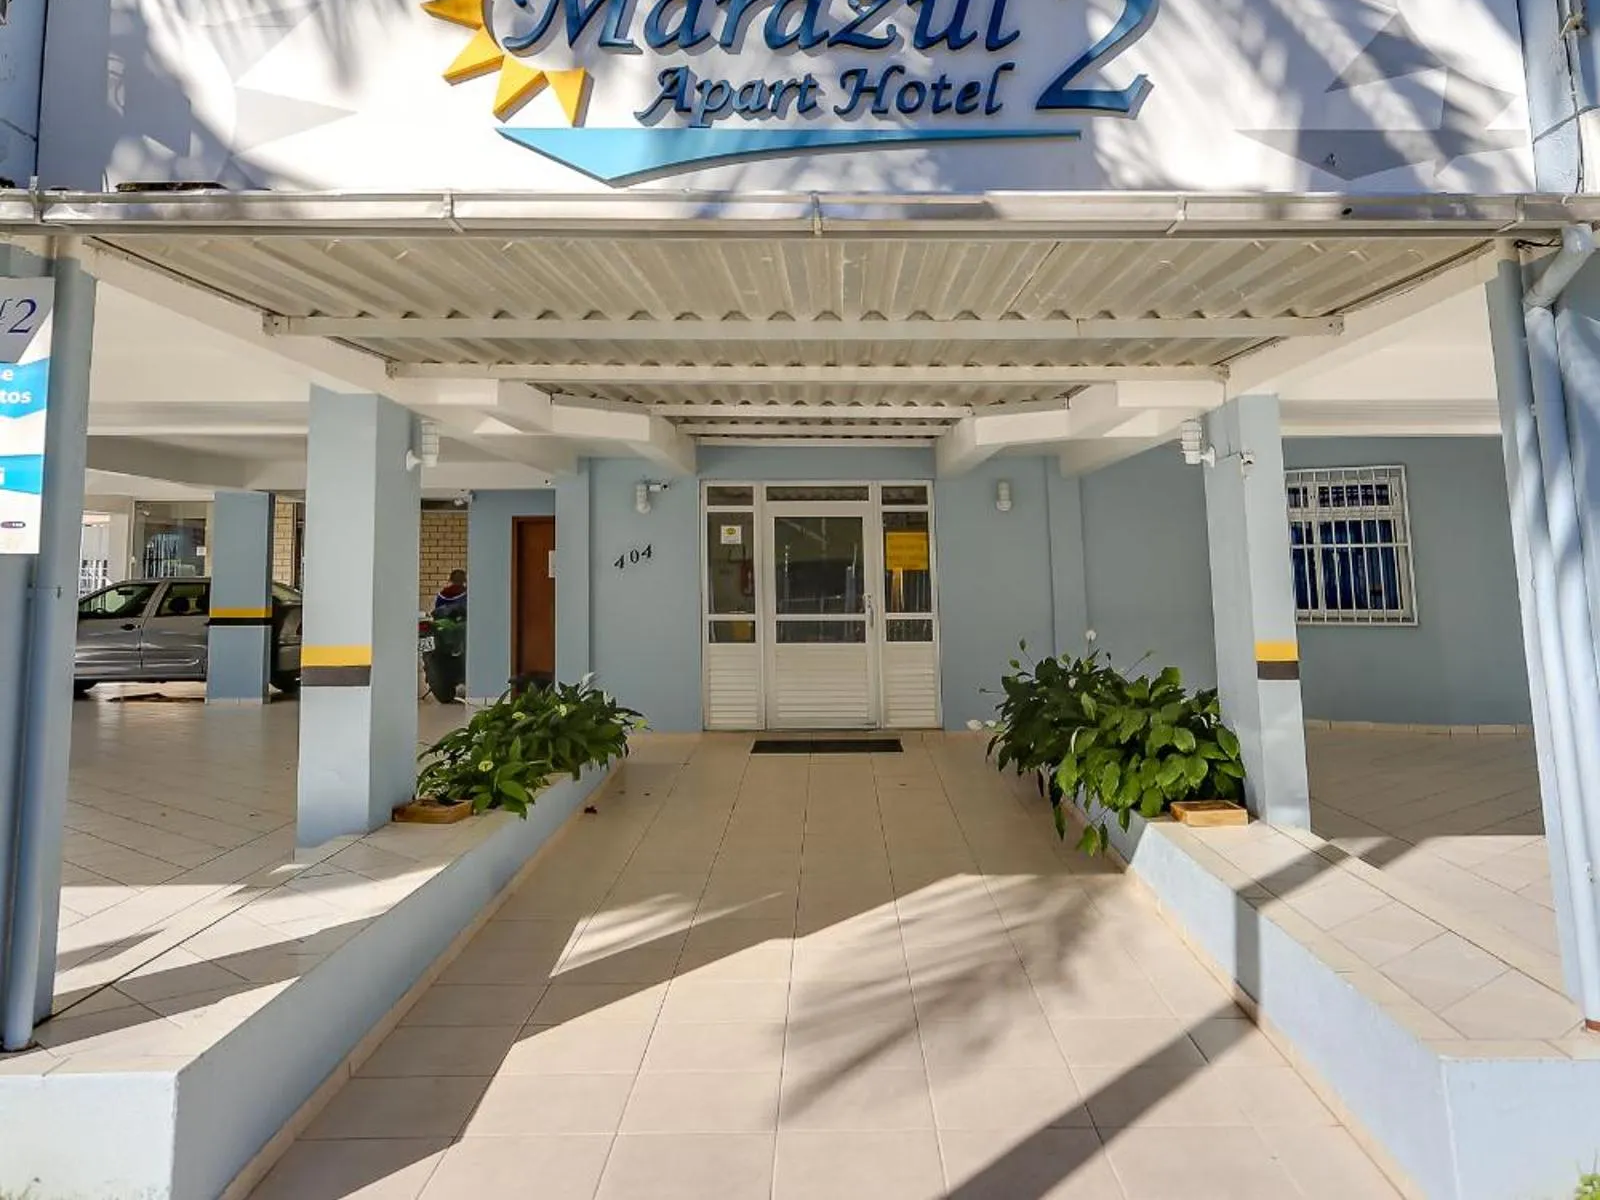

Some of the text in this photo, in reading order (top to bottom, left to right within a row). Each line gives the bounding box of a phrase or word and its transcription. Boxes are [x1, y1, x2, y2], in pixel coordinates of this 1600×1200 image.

[634, 62, 1015, 128] Apart Hotel
[7, 298, 37, 333] 2
[613, 544, 652, 569] 404
